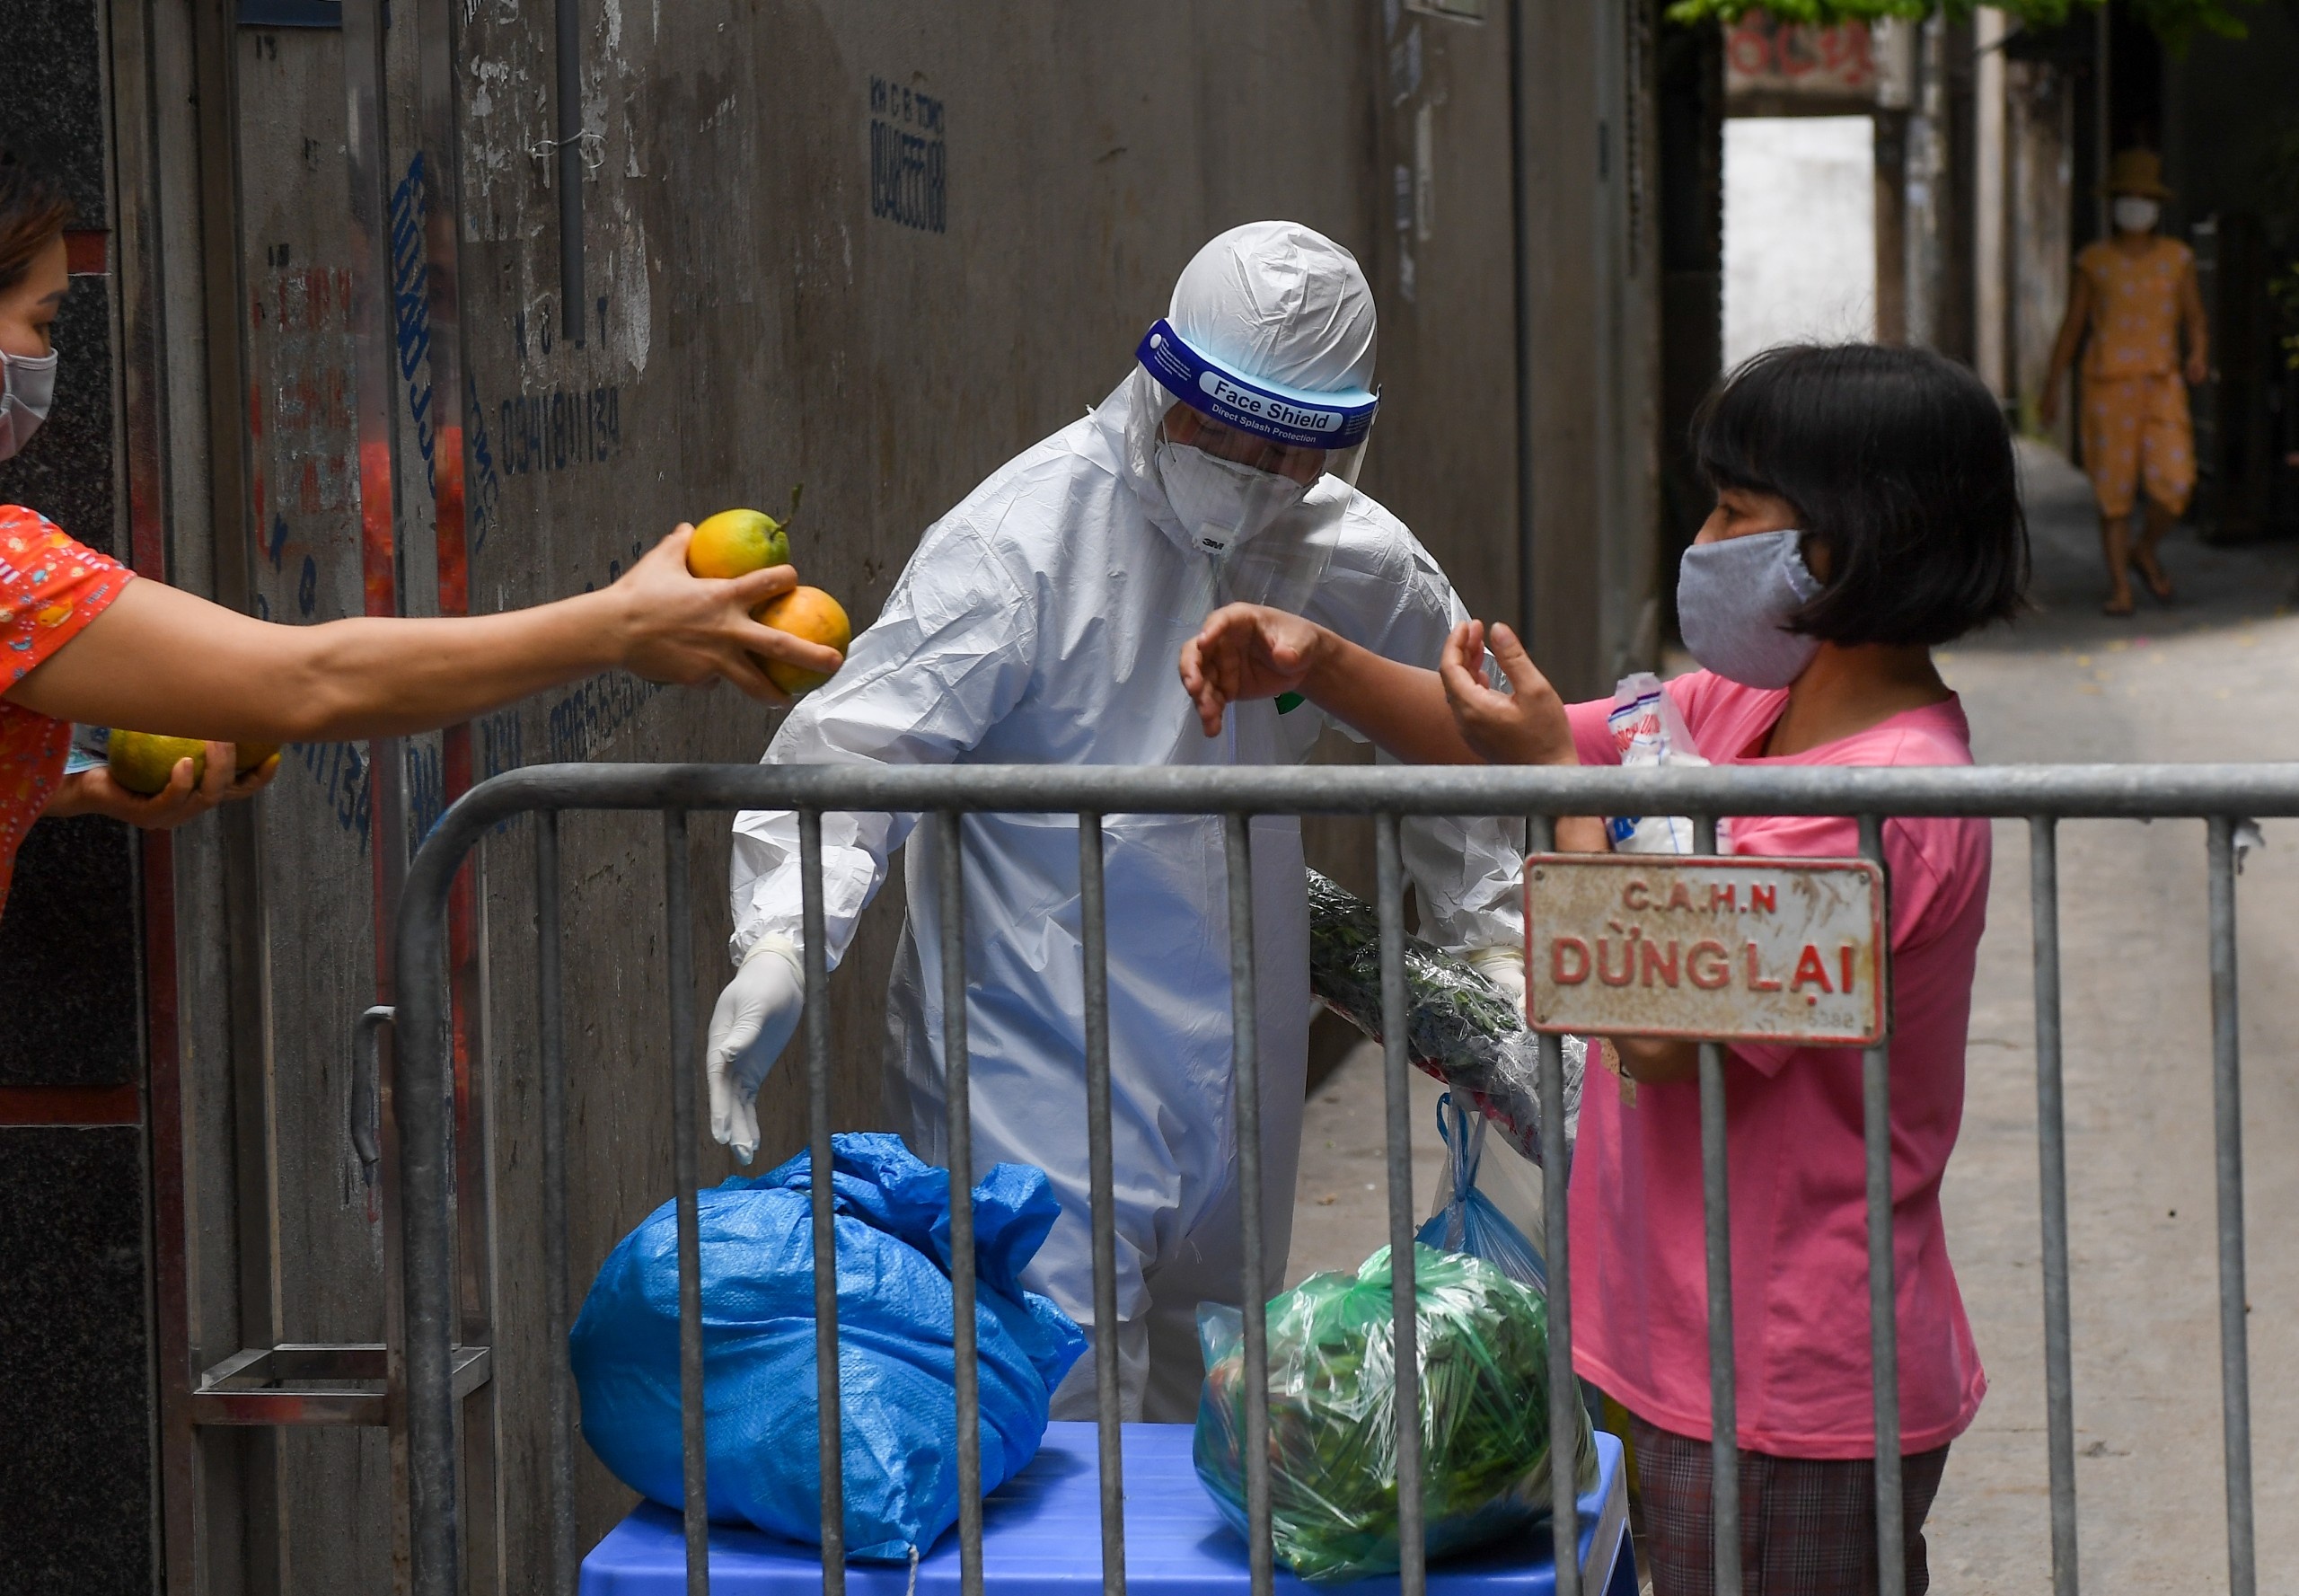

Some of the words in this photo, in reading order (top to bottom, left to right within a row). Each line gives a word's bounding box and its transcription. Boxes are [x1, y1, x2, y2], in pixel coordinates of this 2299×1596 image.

[1211, 403, 1238, 422] Direct
[1239, 416, 1271, 433] Splash
[1272, 427, 1317, 443] Protection
[1214, 380, 1261, 412] Face
[1267, 402, 1330, 428] Shield
[1202, 538, 1224, 550] 3M
[1623, 880, 1776, 914] C.A.H.N
[1550, 919, 1731, 990] DỪNG
[1746, 941, 1854, 1007] LẠI
